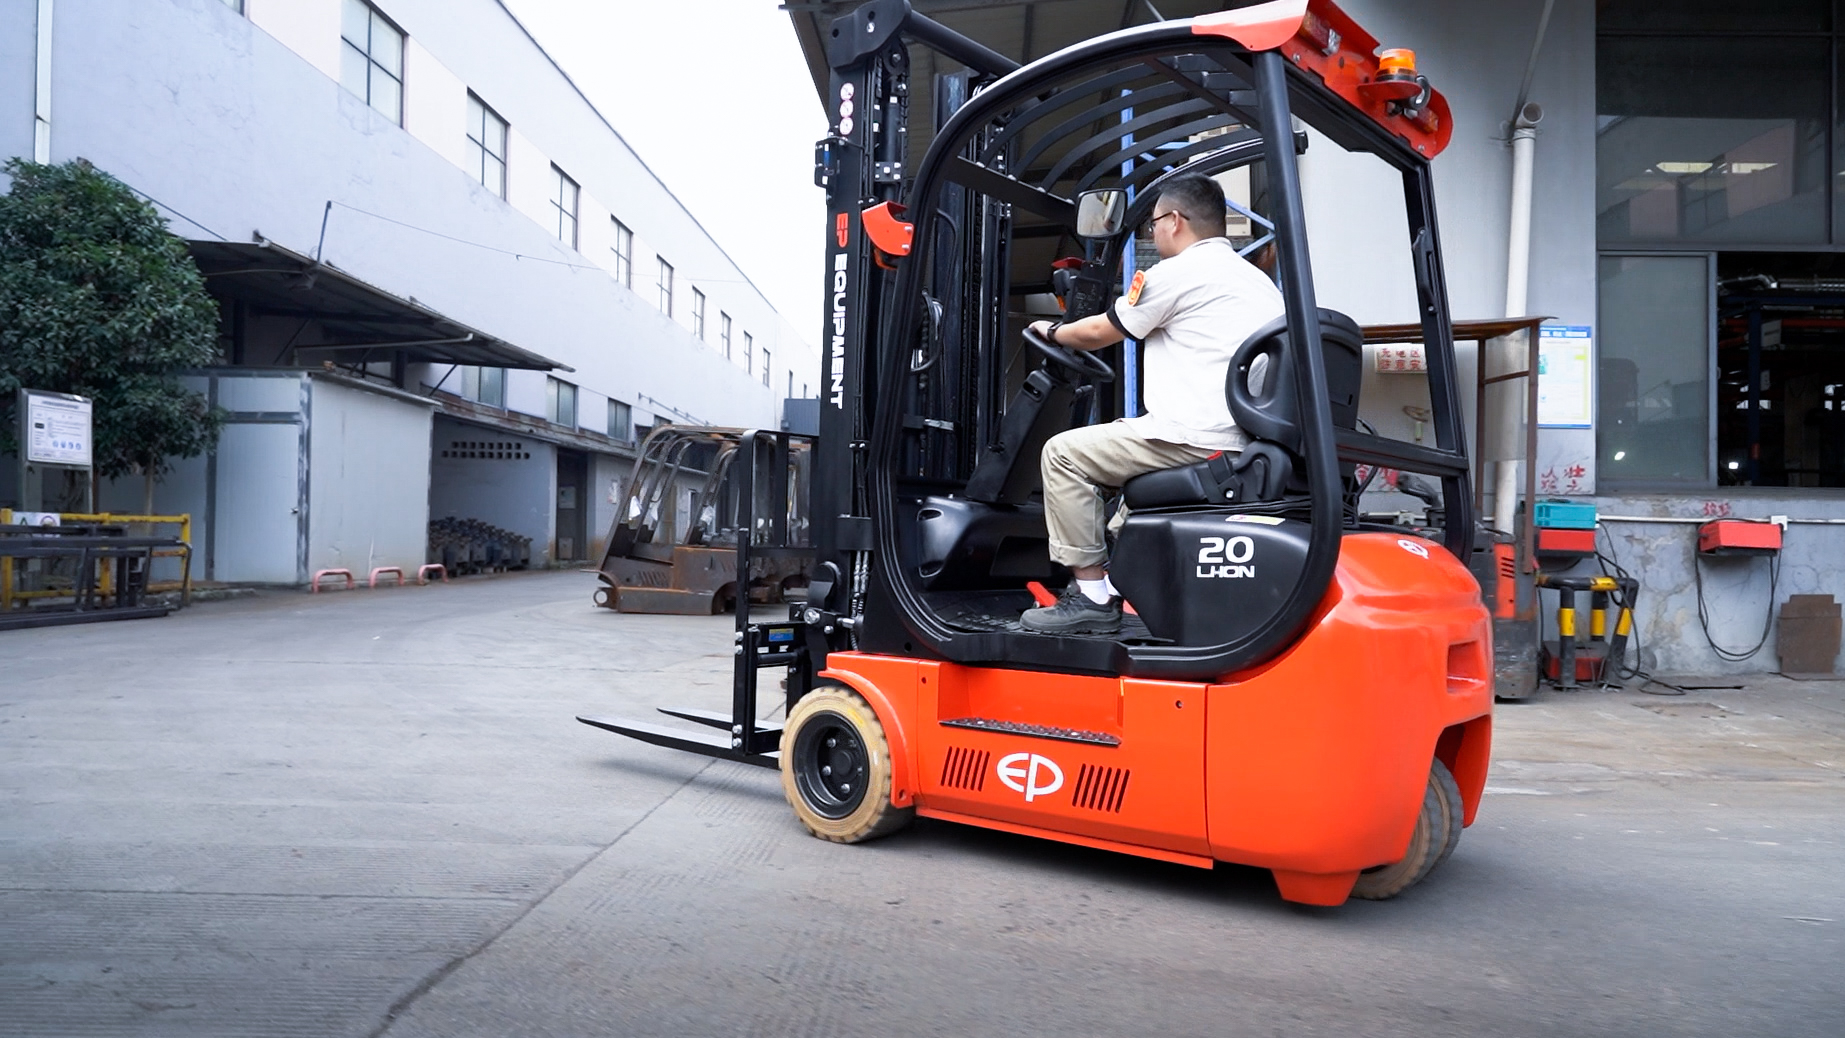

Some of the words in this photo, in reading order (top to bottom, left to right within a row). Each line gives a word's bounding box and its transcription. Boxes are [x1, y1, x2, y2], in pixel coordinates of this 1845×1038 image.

[836, 213, 848, 248] EP
[830, 253, 848, 410] EQUIPMENT
[1198, 536, 1255, 564] 20
[1196, 565, 1255, 579] LHON
[996, 752, 1064, 803] EP
